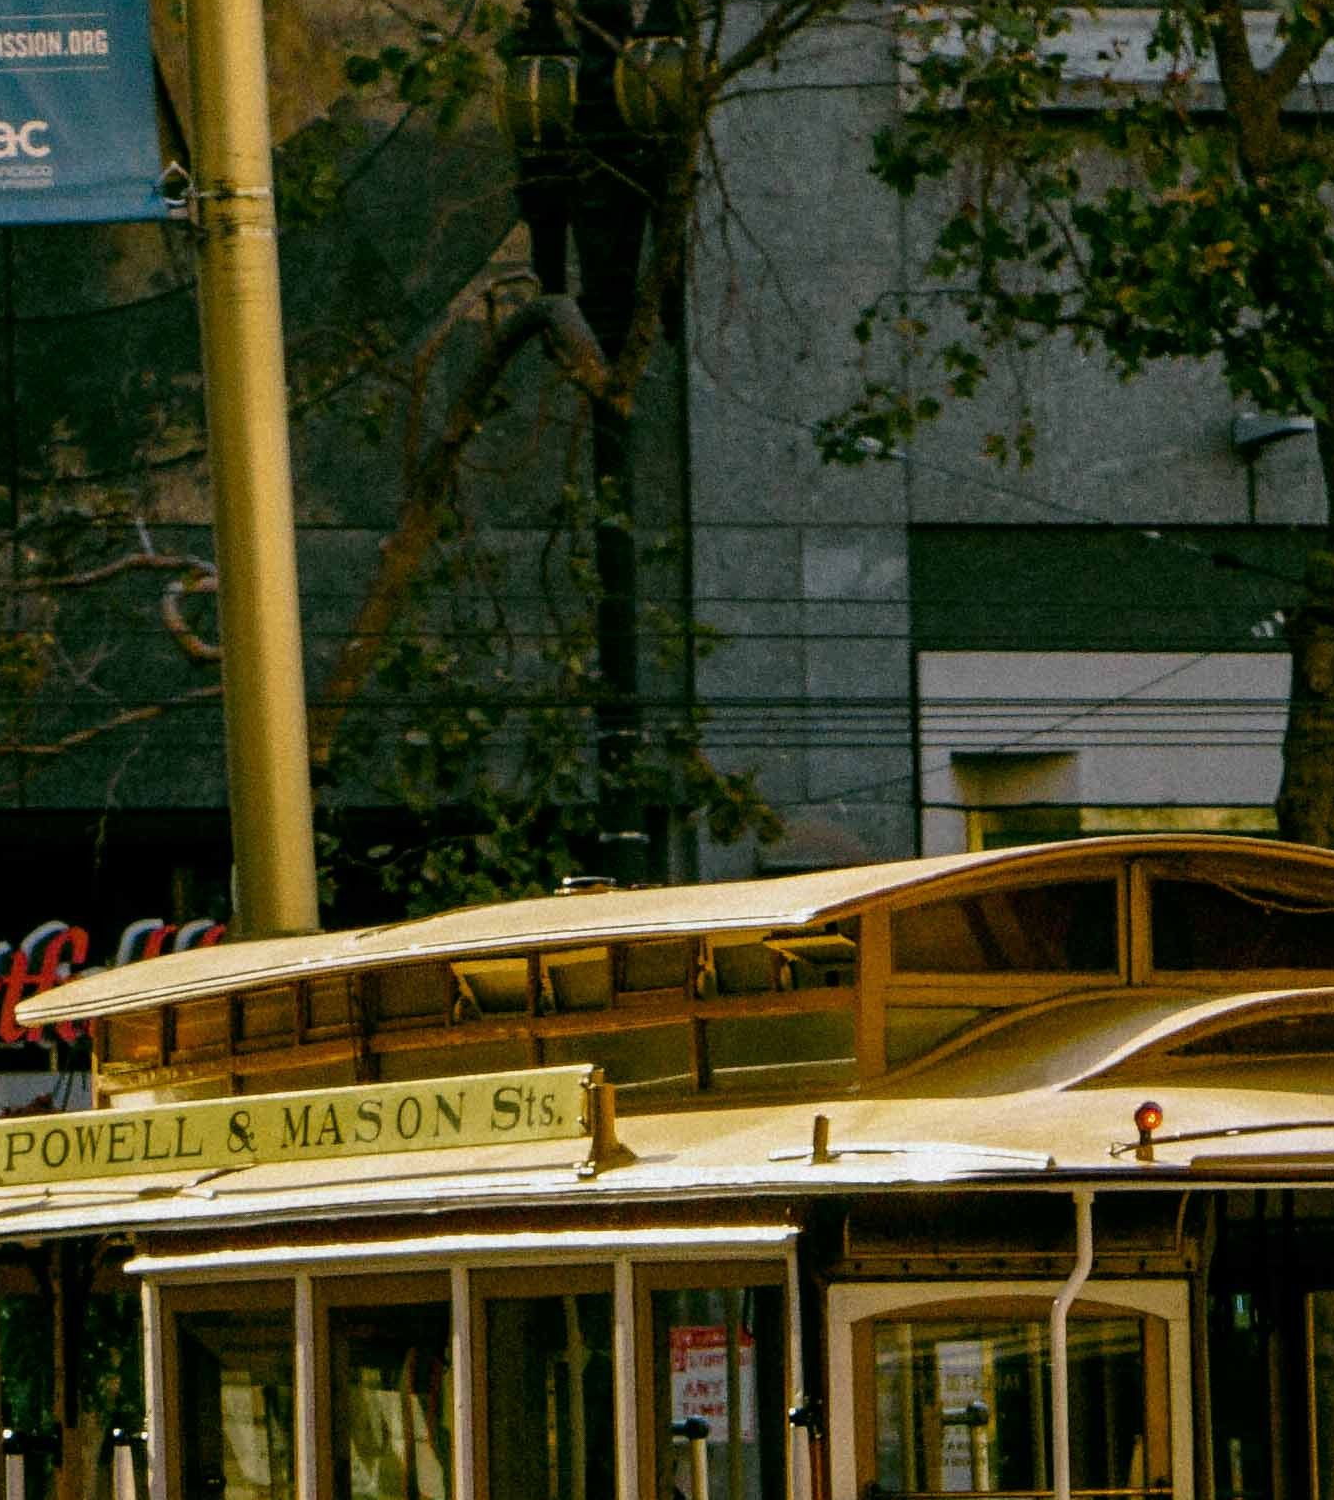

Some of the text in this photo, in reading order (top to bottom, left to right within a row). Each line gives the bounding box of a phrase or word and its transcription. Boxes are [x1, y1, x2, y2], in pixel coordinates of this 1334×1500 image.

[3, 1085, 564, 1172] POWELL & MASON Sts.
